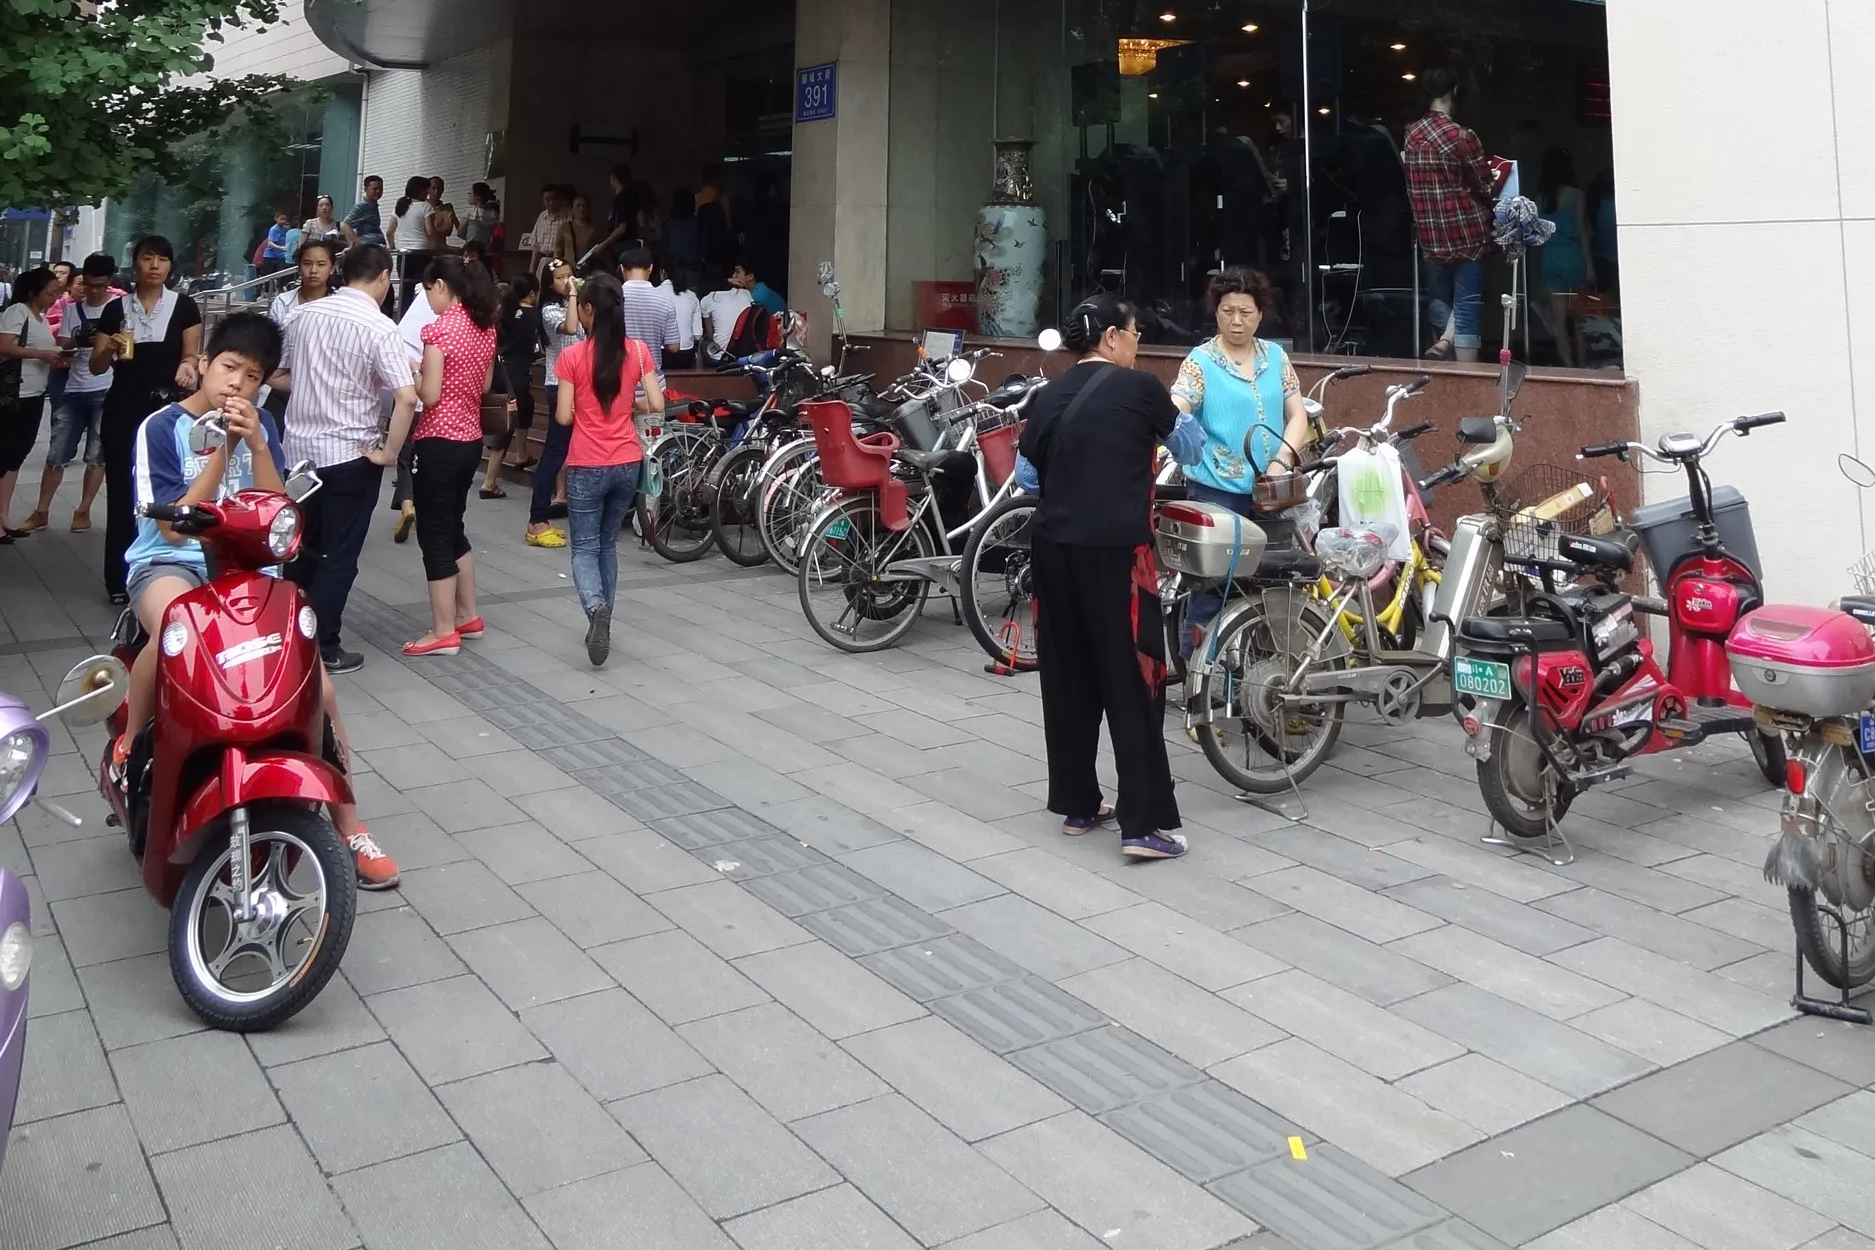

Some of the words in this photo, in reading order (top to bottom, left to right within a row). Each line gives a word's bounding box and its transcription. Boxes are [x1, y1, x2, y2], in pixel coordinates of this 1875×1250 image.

[804, 83, 828, 108] 391
[184, 453, 253, 480] SPRT
[1459, 674, 1506, 695] 080202
